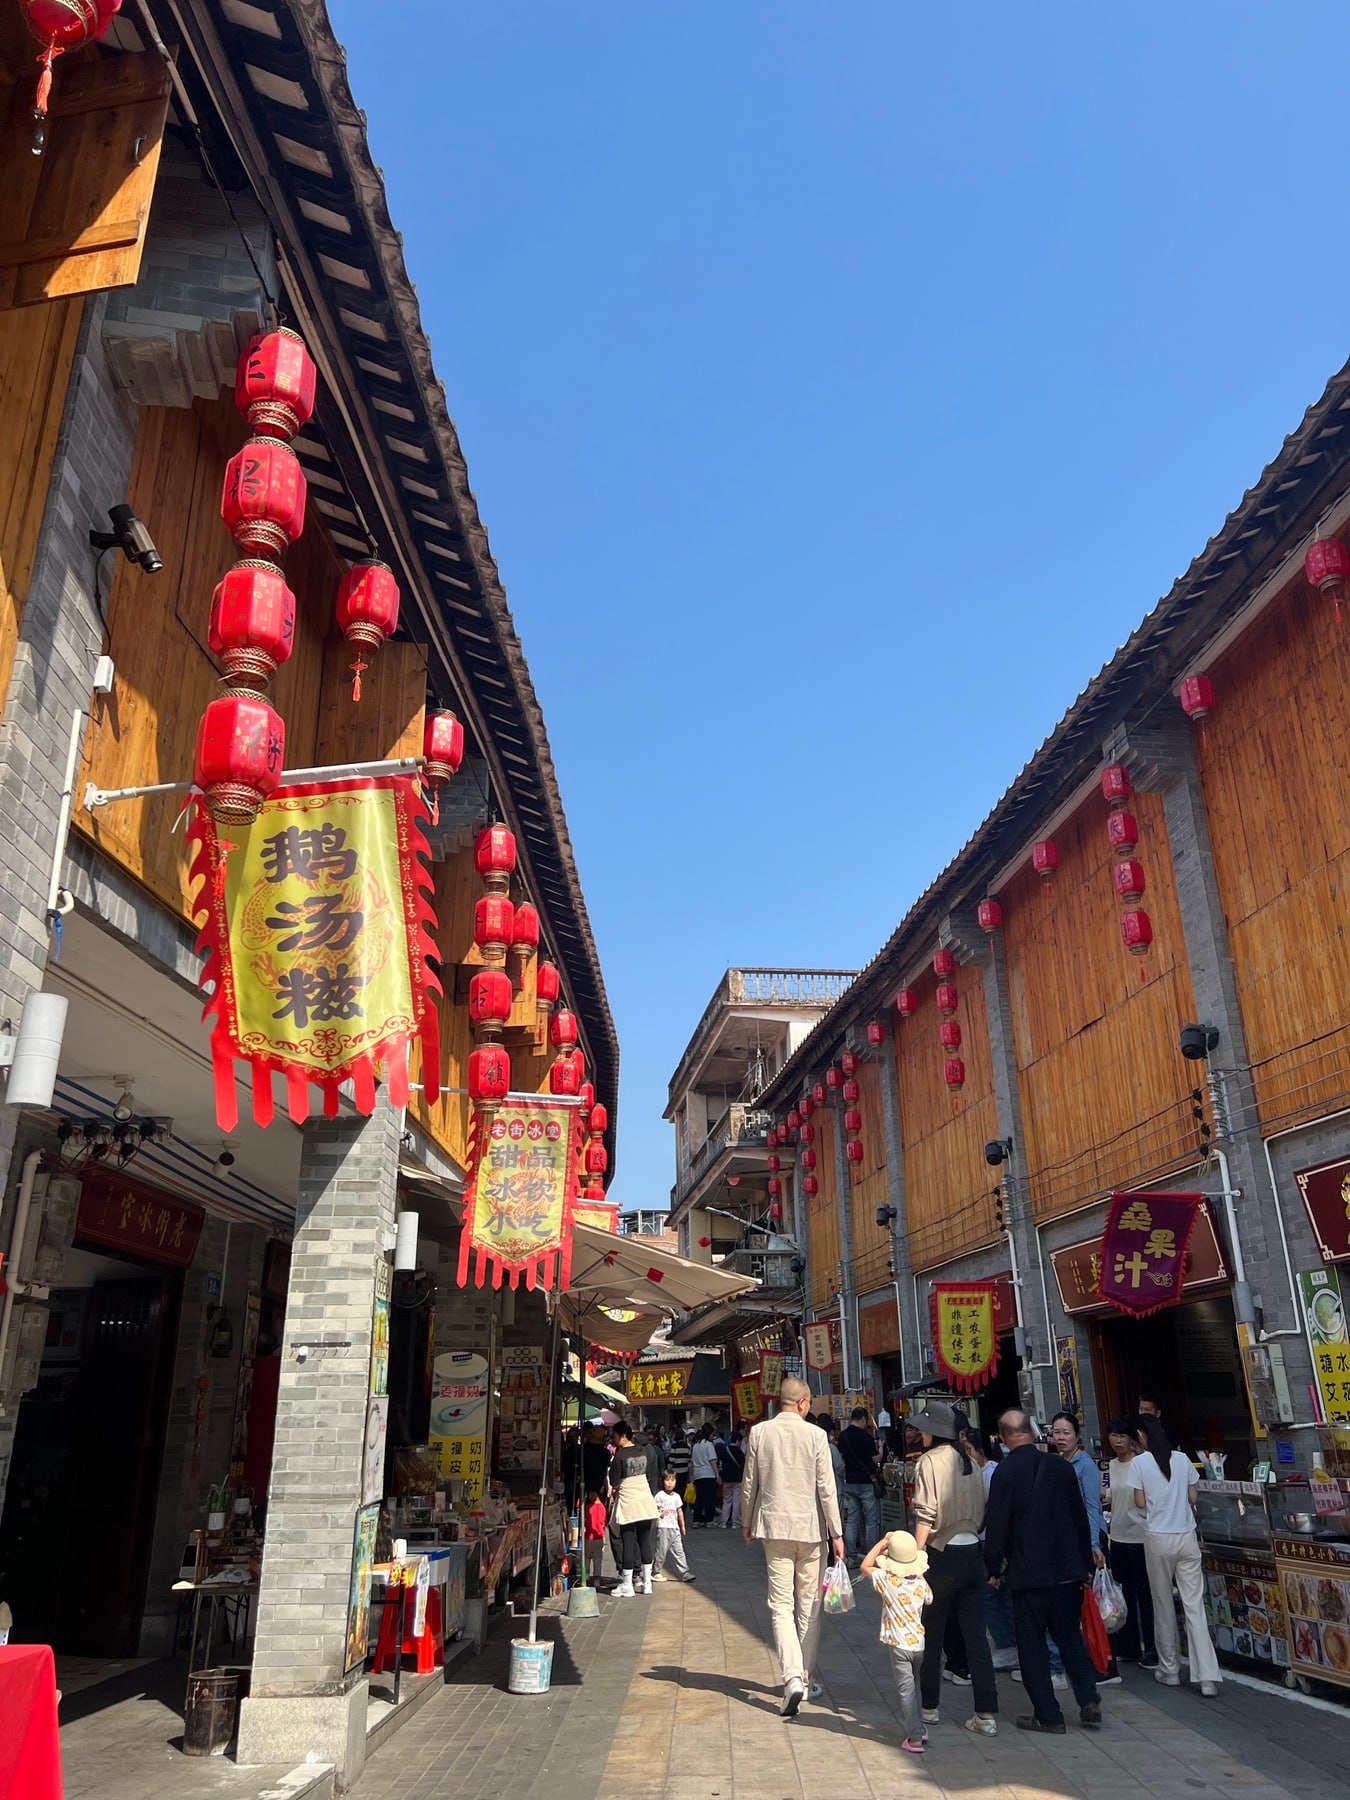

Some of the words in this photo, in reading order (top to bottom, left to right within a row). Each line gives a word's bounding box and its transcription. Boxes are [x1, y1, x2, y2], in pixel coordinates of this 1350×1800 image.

[260, 822, 373, 1029] 鹅汤糍
[491, 1122, 560, 1140] 老街冰室
[488, 1144, 557, 1169] 甜品
[484, 1177, 556, 1203] 冰饮
[481, 1212, 554, 1238] 小吃
[1113, 1201, 1177, 1289] 桑果汁
[951, 1309, 966, 1365] 非遗传承
[968, 1309, 983, 1364] 工农蛋散
[1319, 1351, 1350, 1374] 糖水
